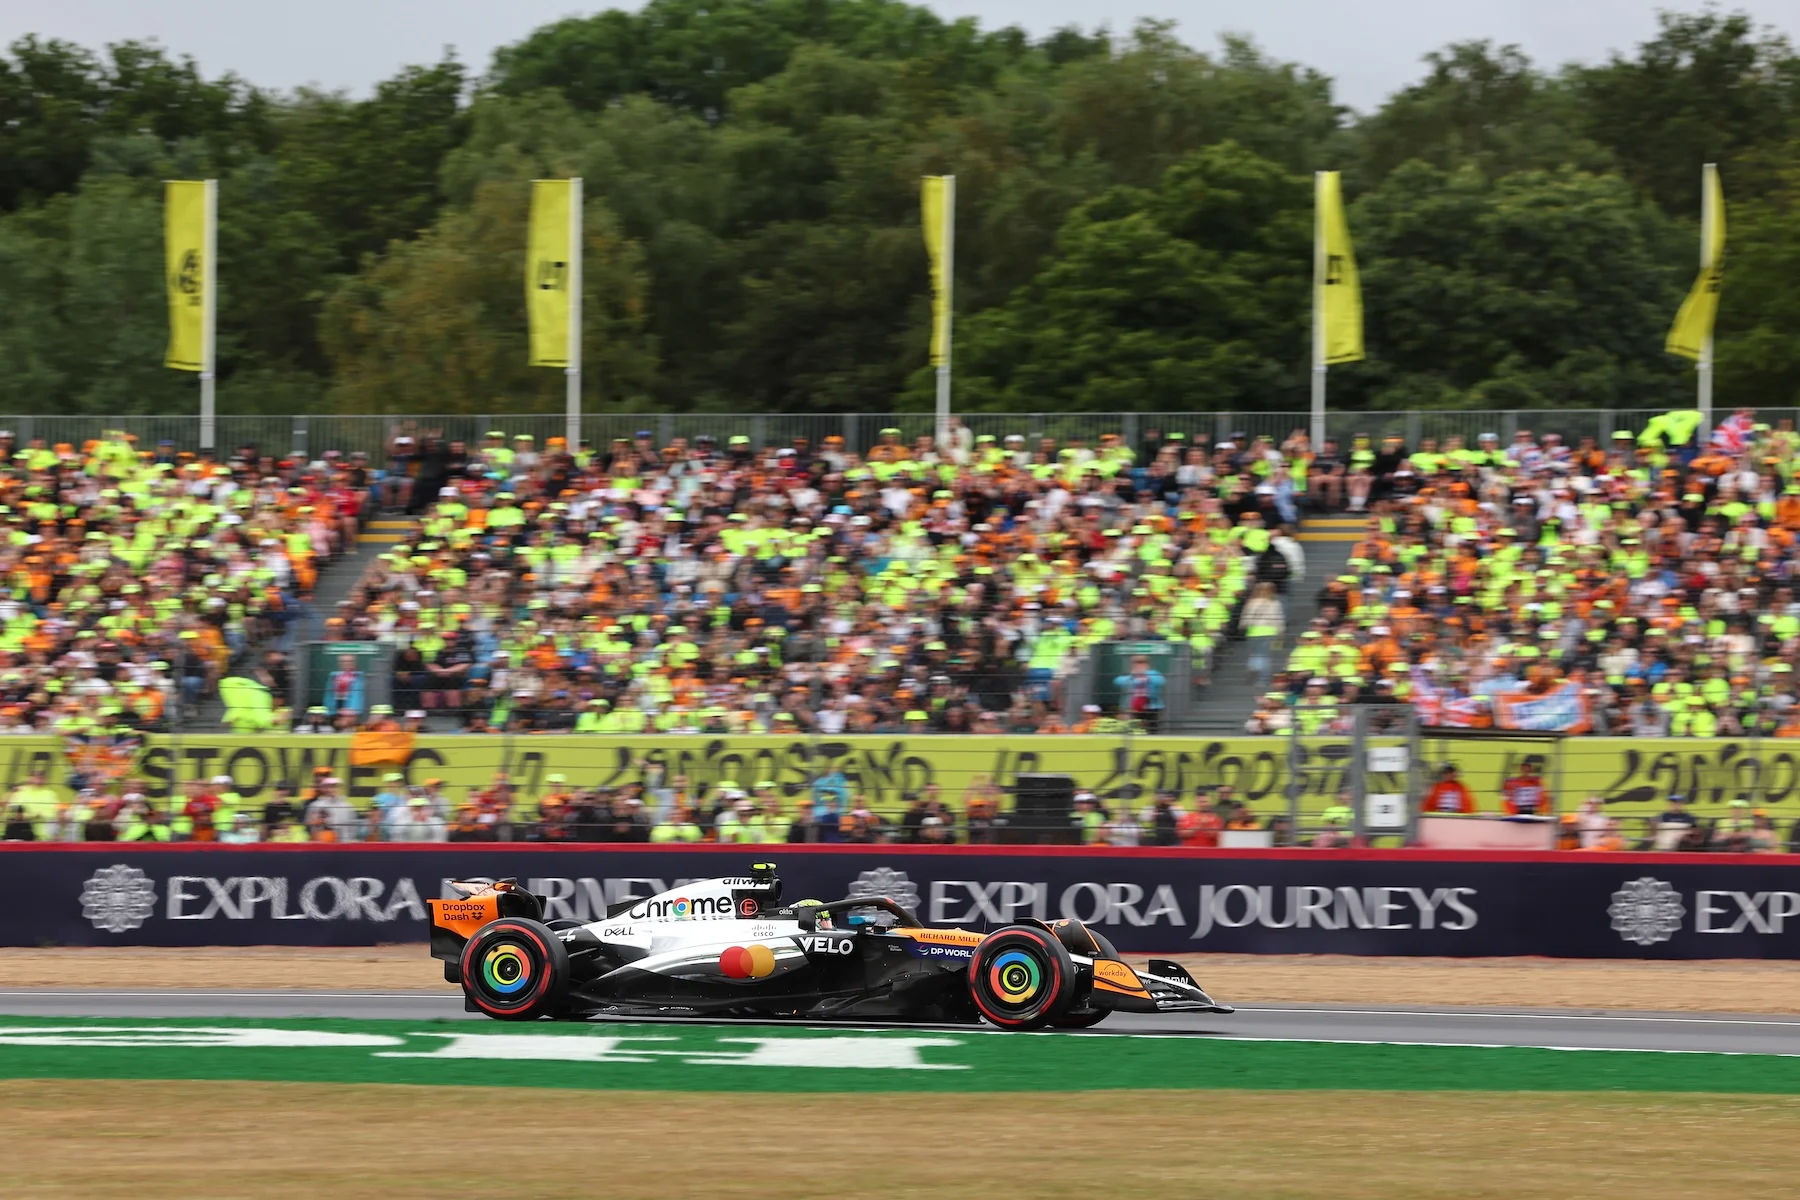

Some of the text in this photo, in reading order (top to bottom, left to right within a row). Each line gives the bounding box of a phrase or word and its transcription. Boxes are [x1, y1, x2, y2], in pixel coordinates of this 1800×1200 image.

[166, 876, 428, 922] EXPLORA
[442, 903, 486, 912] Dropbox
[629, 896, 732, 919] Chrome
[929, 880, 1479, 940] EXPLORA JOURNEYS
[1695, 890, 1800, 934] EXP
[443, 913, 470, 921] Dash
[603, 926, 635, 937] DELL
[920, 932, 956, 941] RICHARD
[799, 936, 854, 955] VELO
[930, 947, 975, 957] DP WORL
[1098, 969, 1128, 978] workday
